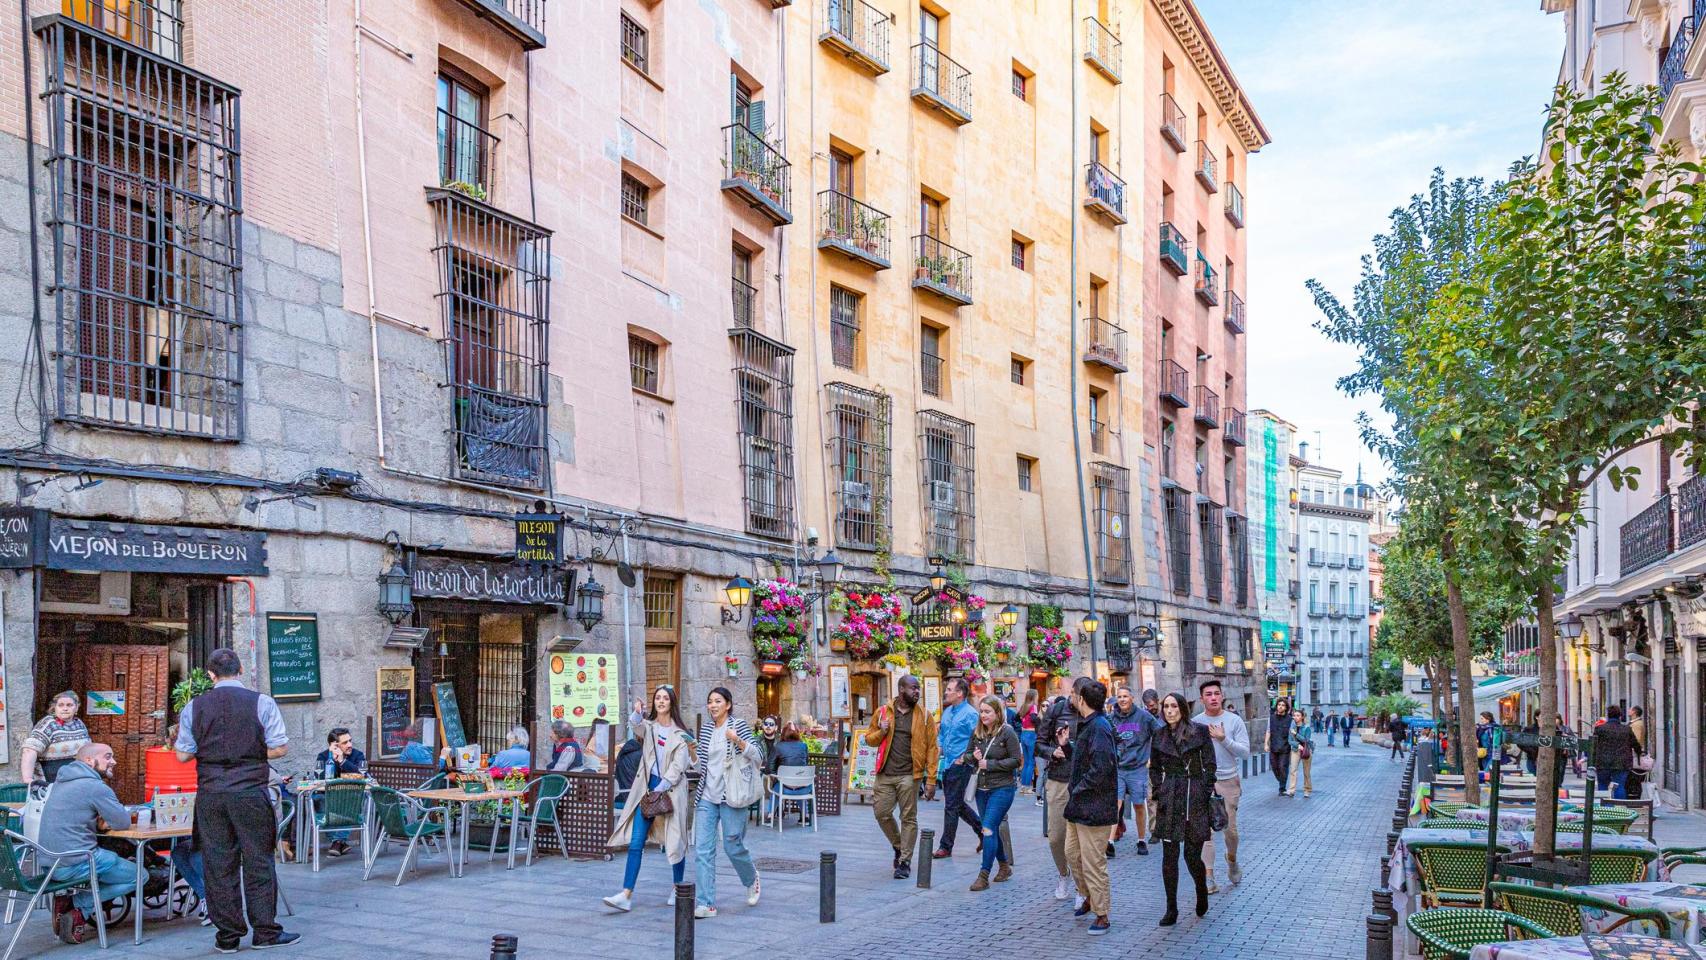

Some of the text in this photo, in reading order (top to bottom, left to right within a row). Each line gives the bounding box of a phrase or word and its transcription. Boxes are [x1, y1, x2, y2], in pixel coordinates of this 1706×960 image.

[0, 516, 29, 537] ESON
[526, 534, 547, 546] de la
[49, 535, 118, 559] MESON
[122, 544, 151, 557] DEL
[517, 548, 555, 560] tortilla
[414, 565, 565, 599] meson de la tortilla
[946, 587, 961, 600] CAVA
[921, 626, 953, 638] MESON
